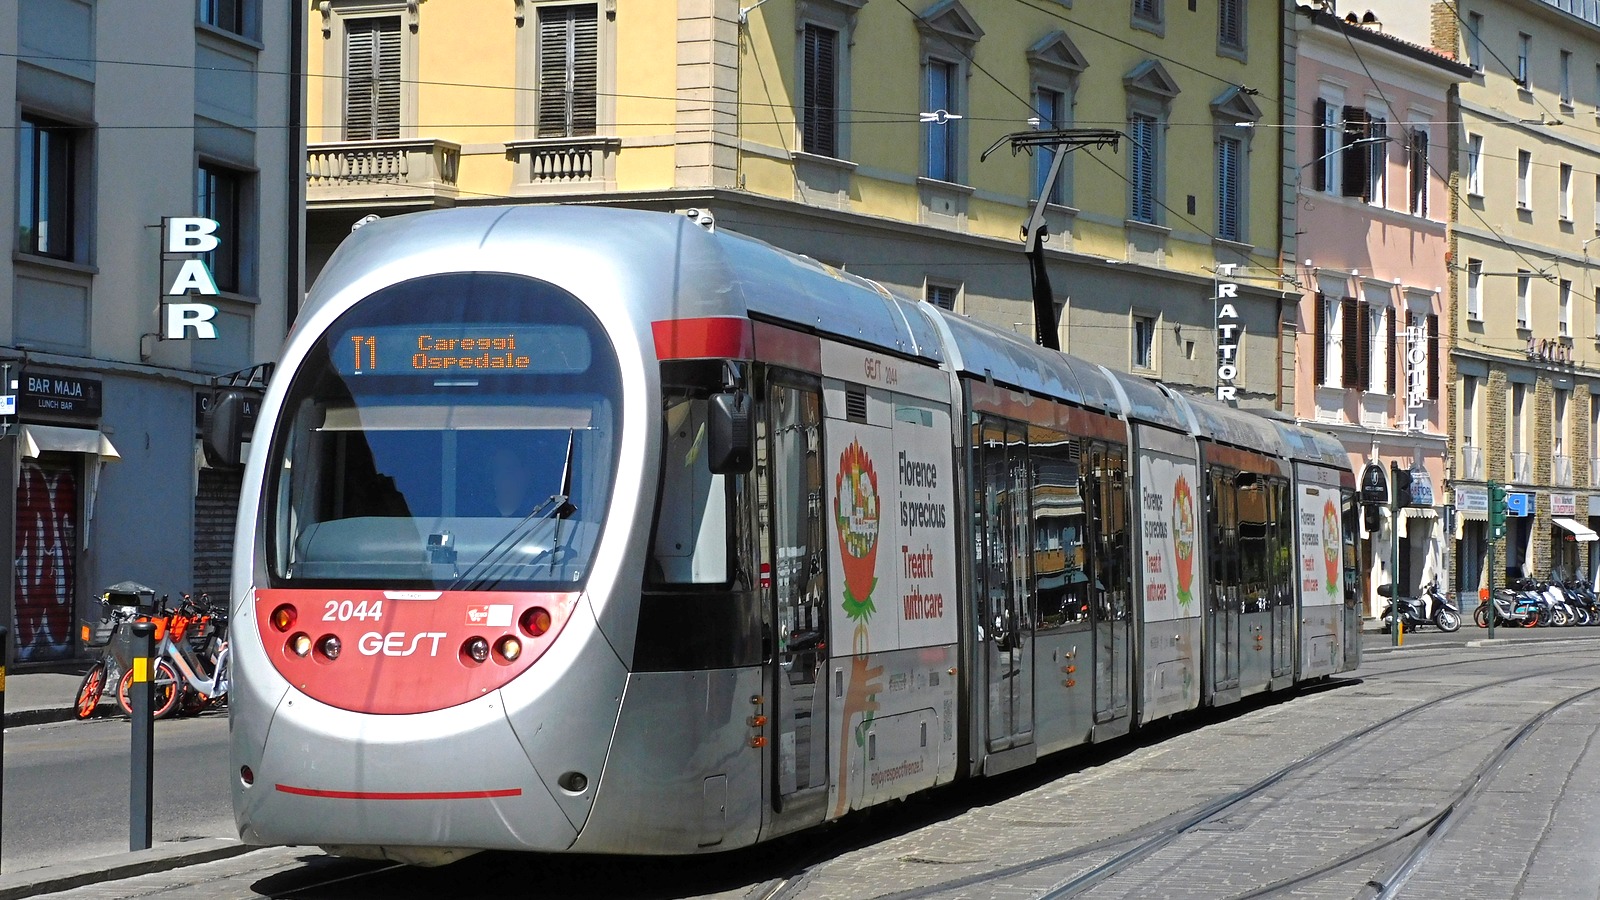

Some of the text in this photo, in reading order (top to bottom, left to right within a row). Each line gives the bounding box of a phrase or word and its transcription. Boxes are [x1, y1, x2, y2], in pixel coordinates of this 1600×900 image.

[168, 217, 221, 339] BAR
[351, 335, 376, 370] T1
[418, 334, 516, 350] Careggi
[411, 352, 530, 369] Ospedale
[865, 357, 898, 385] GEST 2044
[28, 377, 82, 397] BAR MAJA
[1407, 326, 1425, 430] HOTEL
[38, 400, 73, 411] LUNCH BAR
[899, 450, 937, 488] Florence
[900, 491, 946, 536] is precious
[902, 544, 934, 579] Treat it
[322, 600, 382, 622] 2044
[903, 585, 943, 620] with care
[358, 632, 447, 657] GEST
